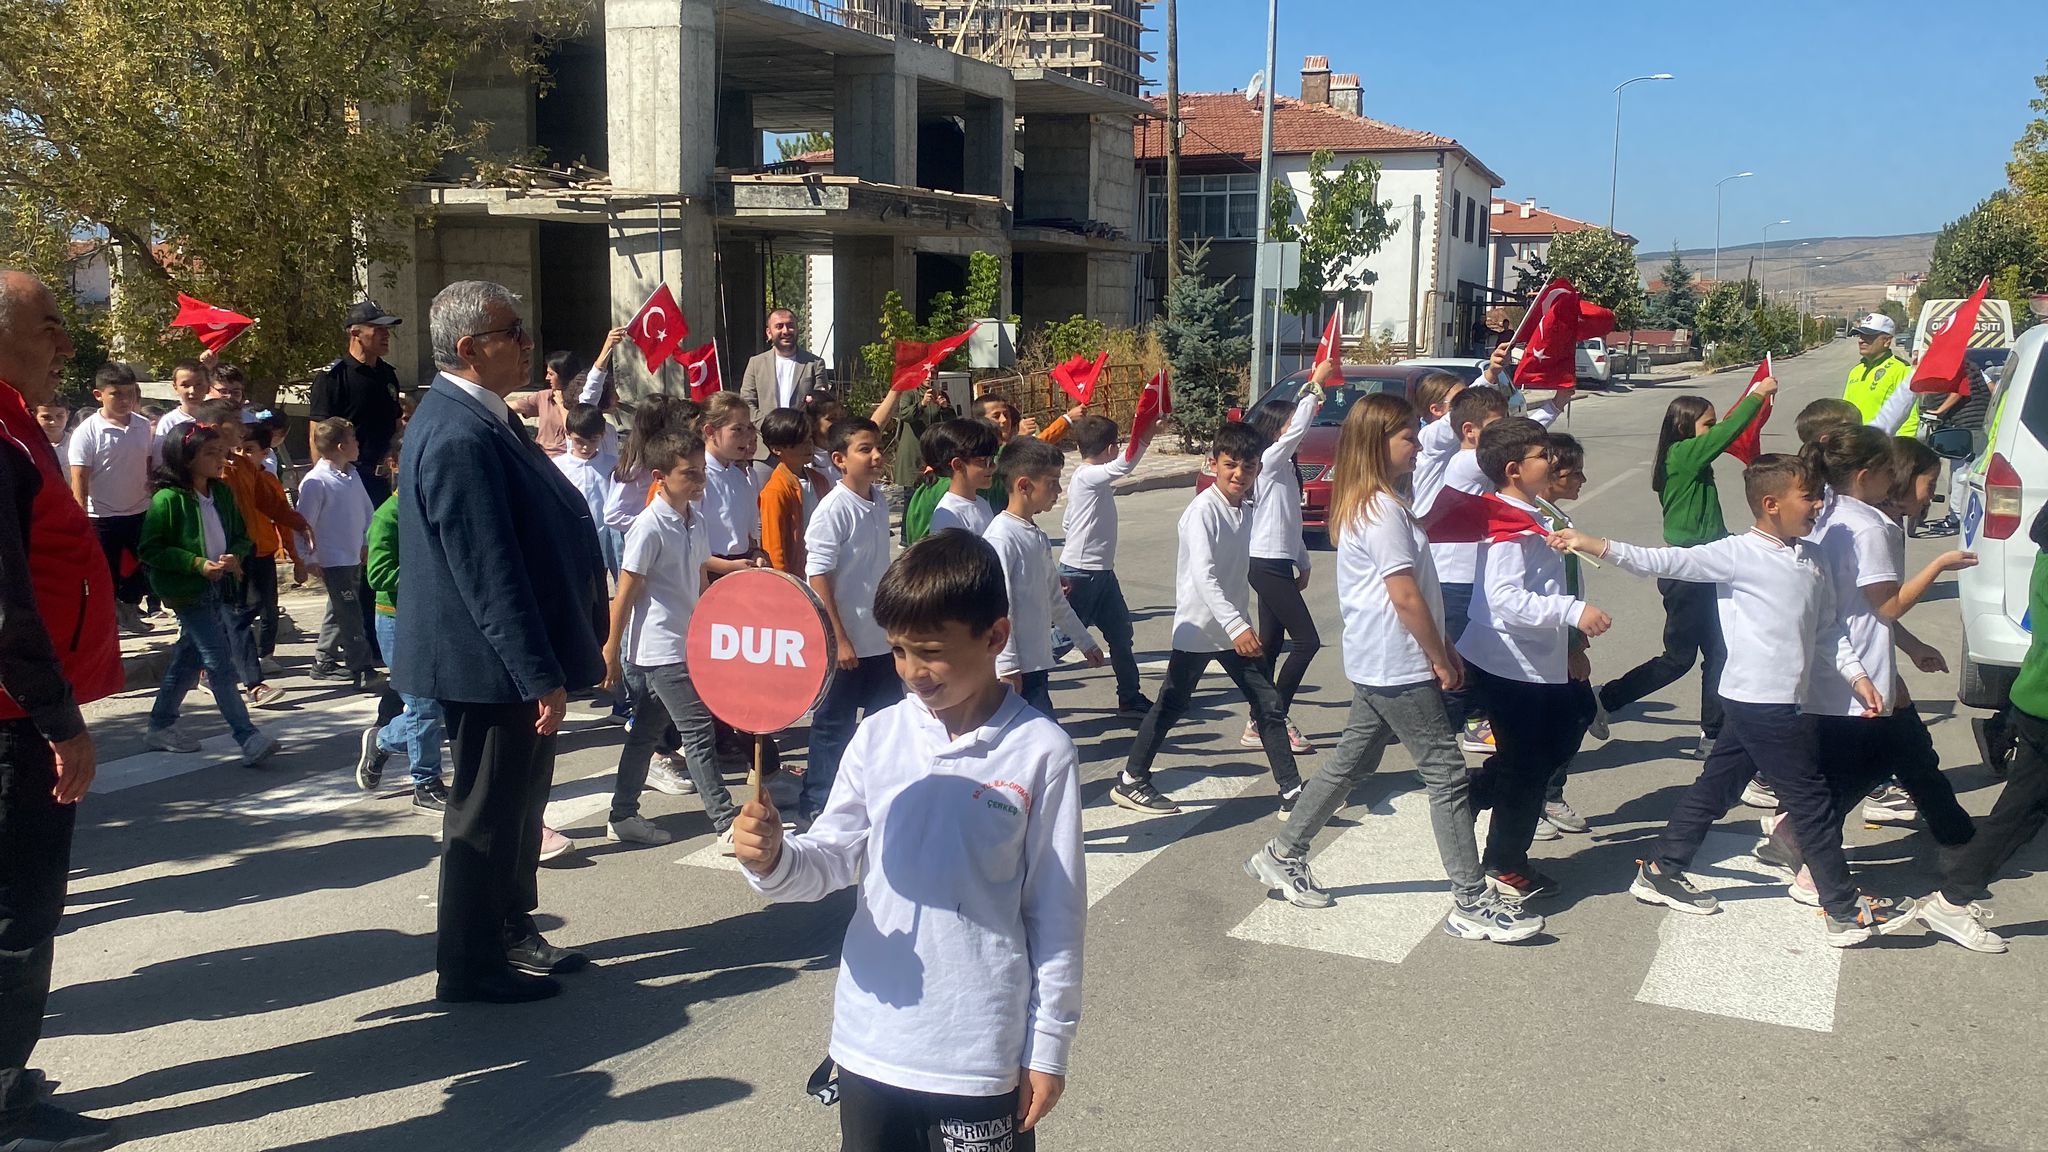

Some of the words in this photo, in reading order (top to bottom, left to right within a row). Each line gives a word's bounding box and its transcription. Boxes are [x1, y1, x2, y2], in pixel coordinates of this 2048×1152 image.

[1973, 322, 2001, 332] AŞITI
[710, 623, 807, 668] DUR
[1285, 867, 1298, 878] N
[1482, 908, 1493, 919] N
[941, 1116, 1012, 1140] NORMAL
